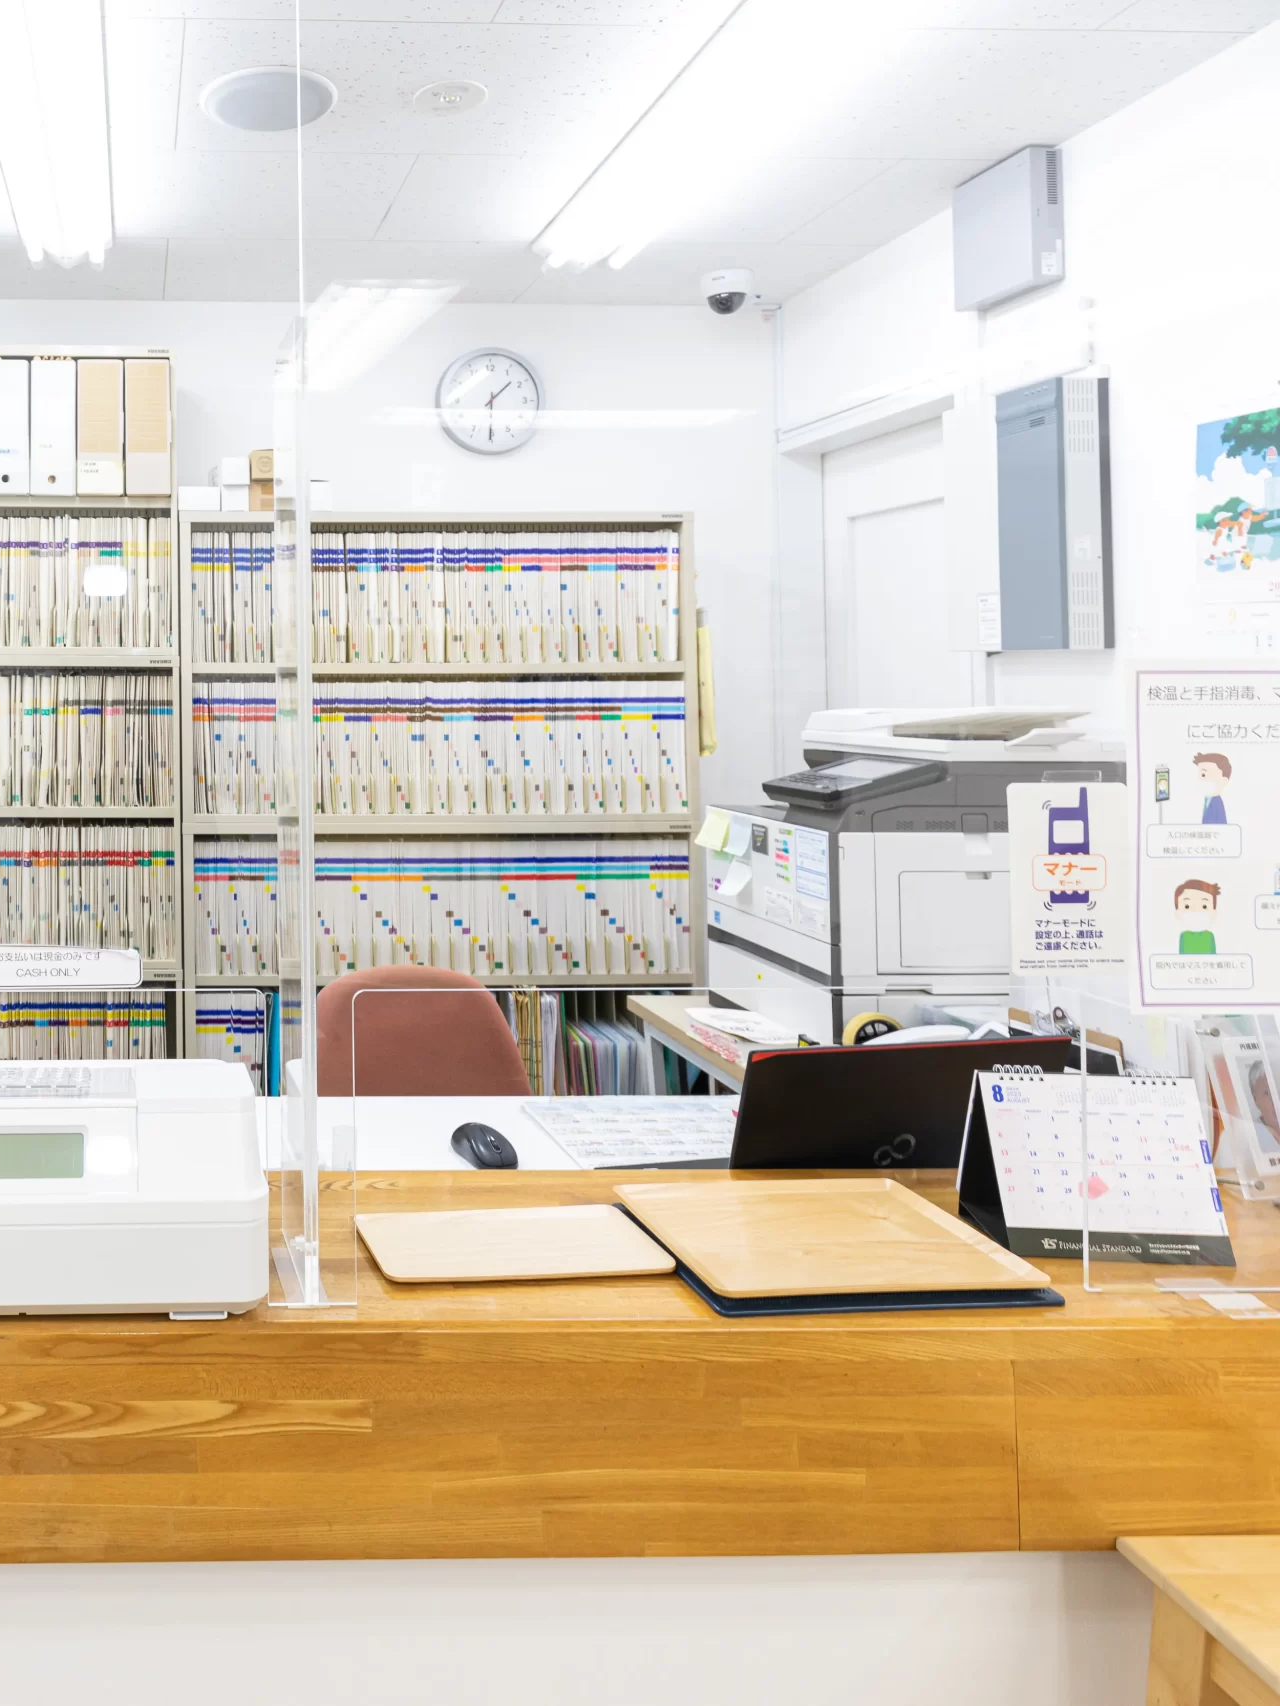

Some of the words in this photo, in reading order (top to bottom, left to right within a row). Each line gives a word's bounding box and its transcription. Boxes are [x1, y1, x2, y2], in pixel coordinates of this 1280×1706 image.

[486, 364, 496, 372] 12
[522, 396, 528, 404] 3
[505, 425, 511, 433] 5
[1043, 861, 1098, 876] マナー
[1035, 919, 1096, 928] マナーモードに
[1035, 929, 1103, 940] 設定の上、通話は
[1035, 941, 1102, 951] ご遠慮ください。
[16, 967, 48, 977] CASH
[50, 967, 81, 977] ONLY
[1187, 977, 1218, 985] ください
[991, 1084, 1005, 1102] 8
[1102, 1243, 1143, 1254] STANDARD
